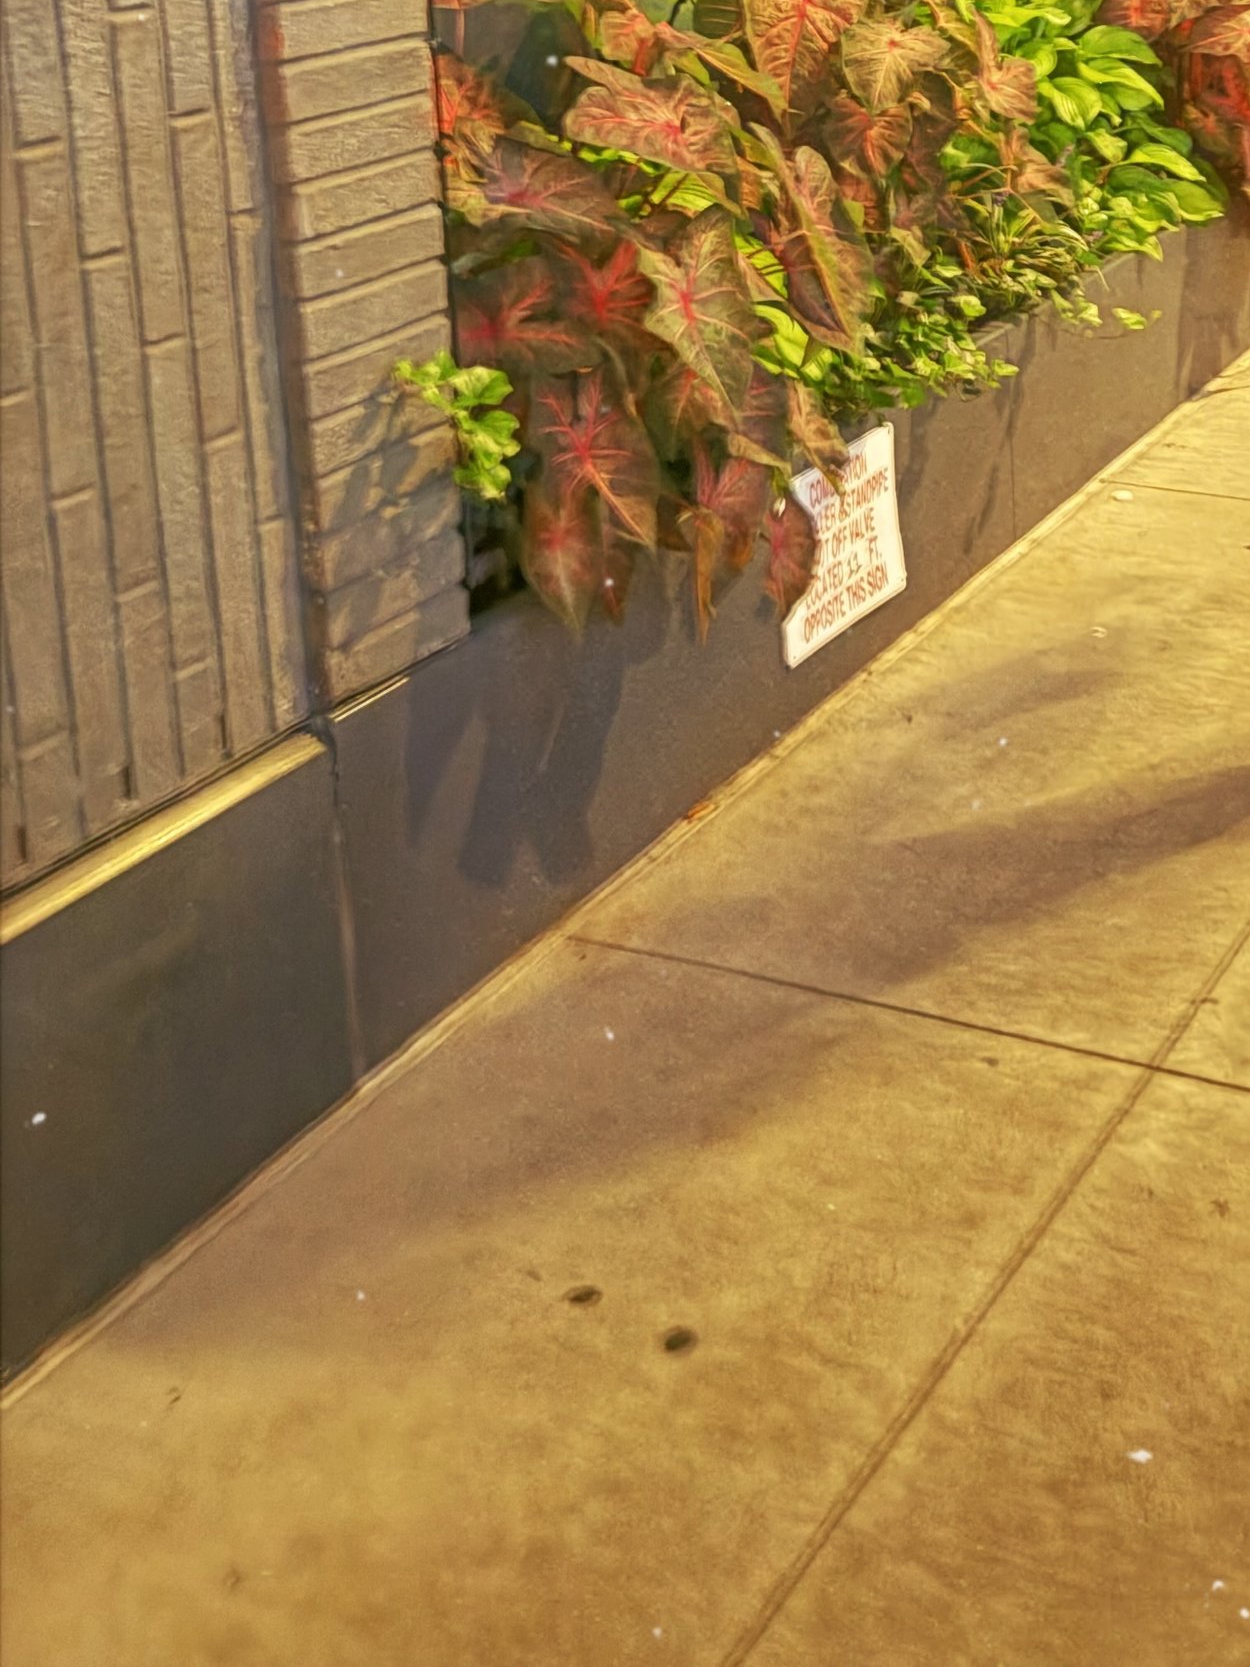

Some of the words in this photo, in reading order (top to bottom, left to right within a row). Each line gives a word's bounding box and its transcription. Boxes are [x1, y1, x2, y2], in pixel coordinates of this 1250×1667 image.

[832, 526, 847, 559] OFF
[849, 506, 876, 545] VALVE
[804, 590, 846, 644] OPPOSITE
[846, 575, 867, 612] THIS
[867, 560, 889, 597] SIGN
